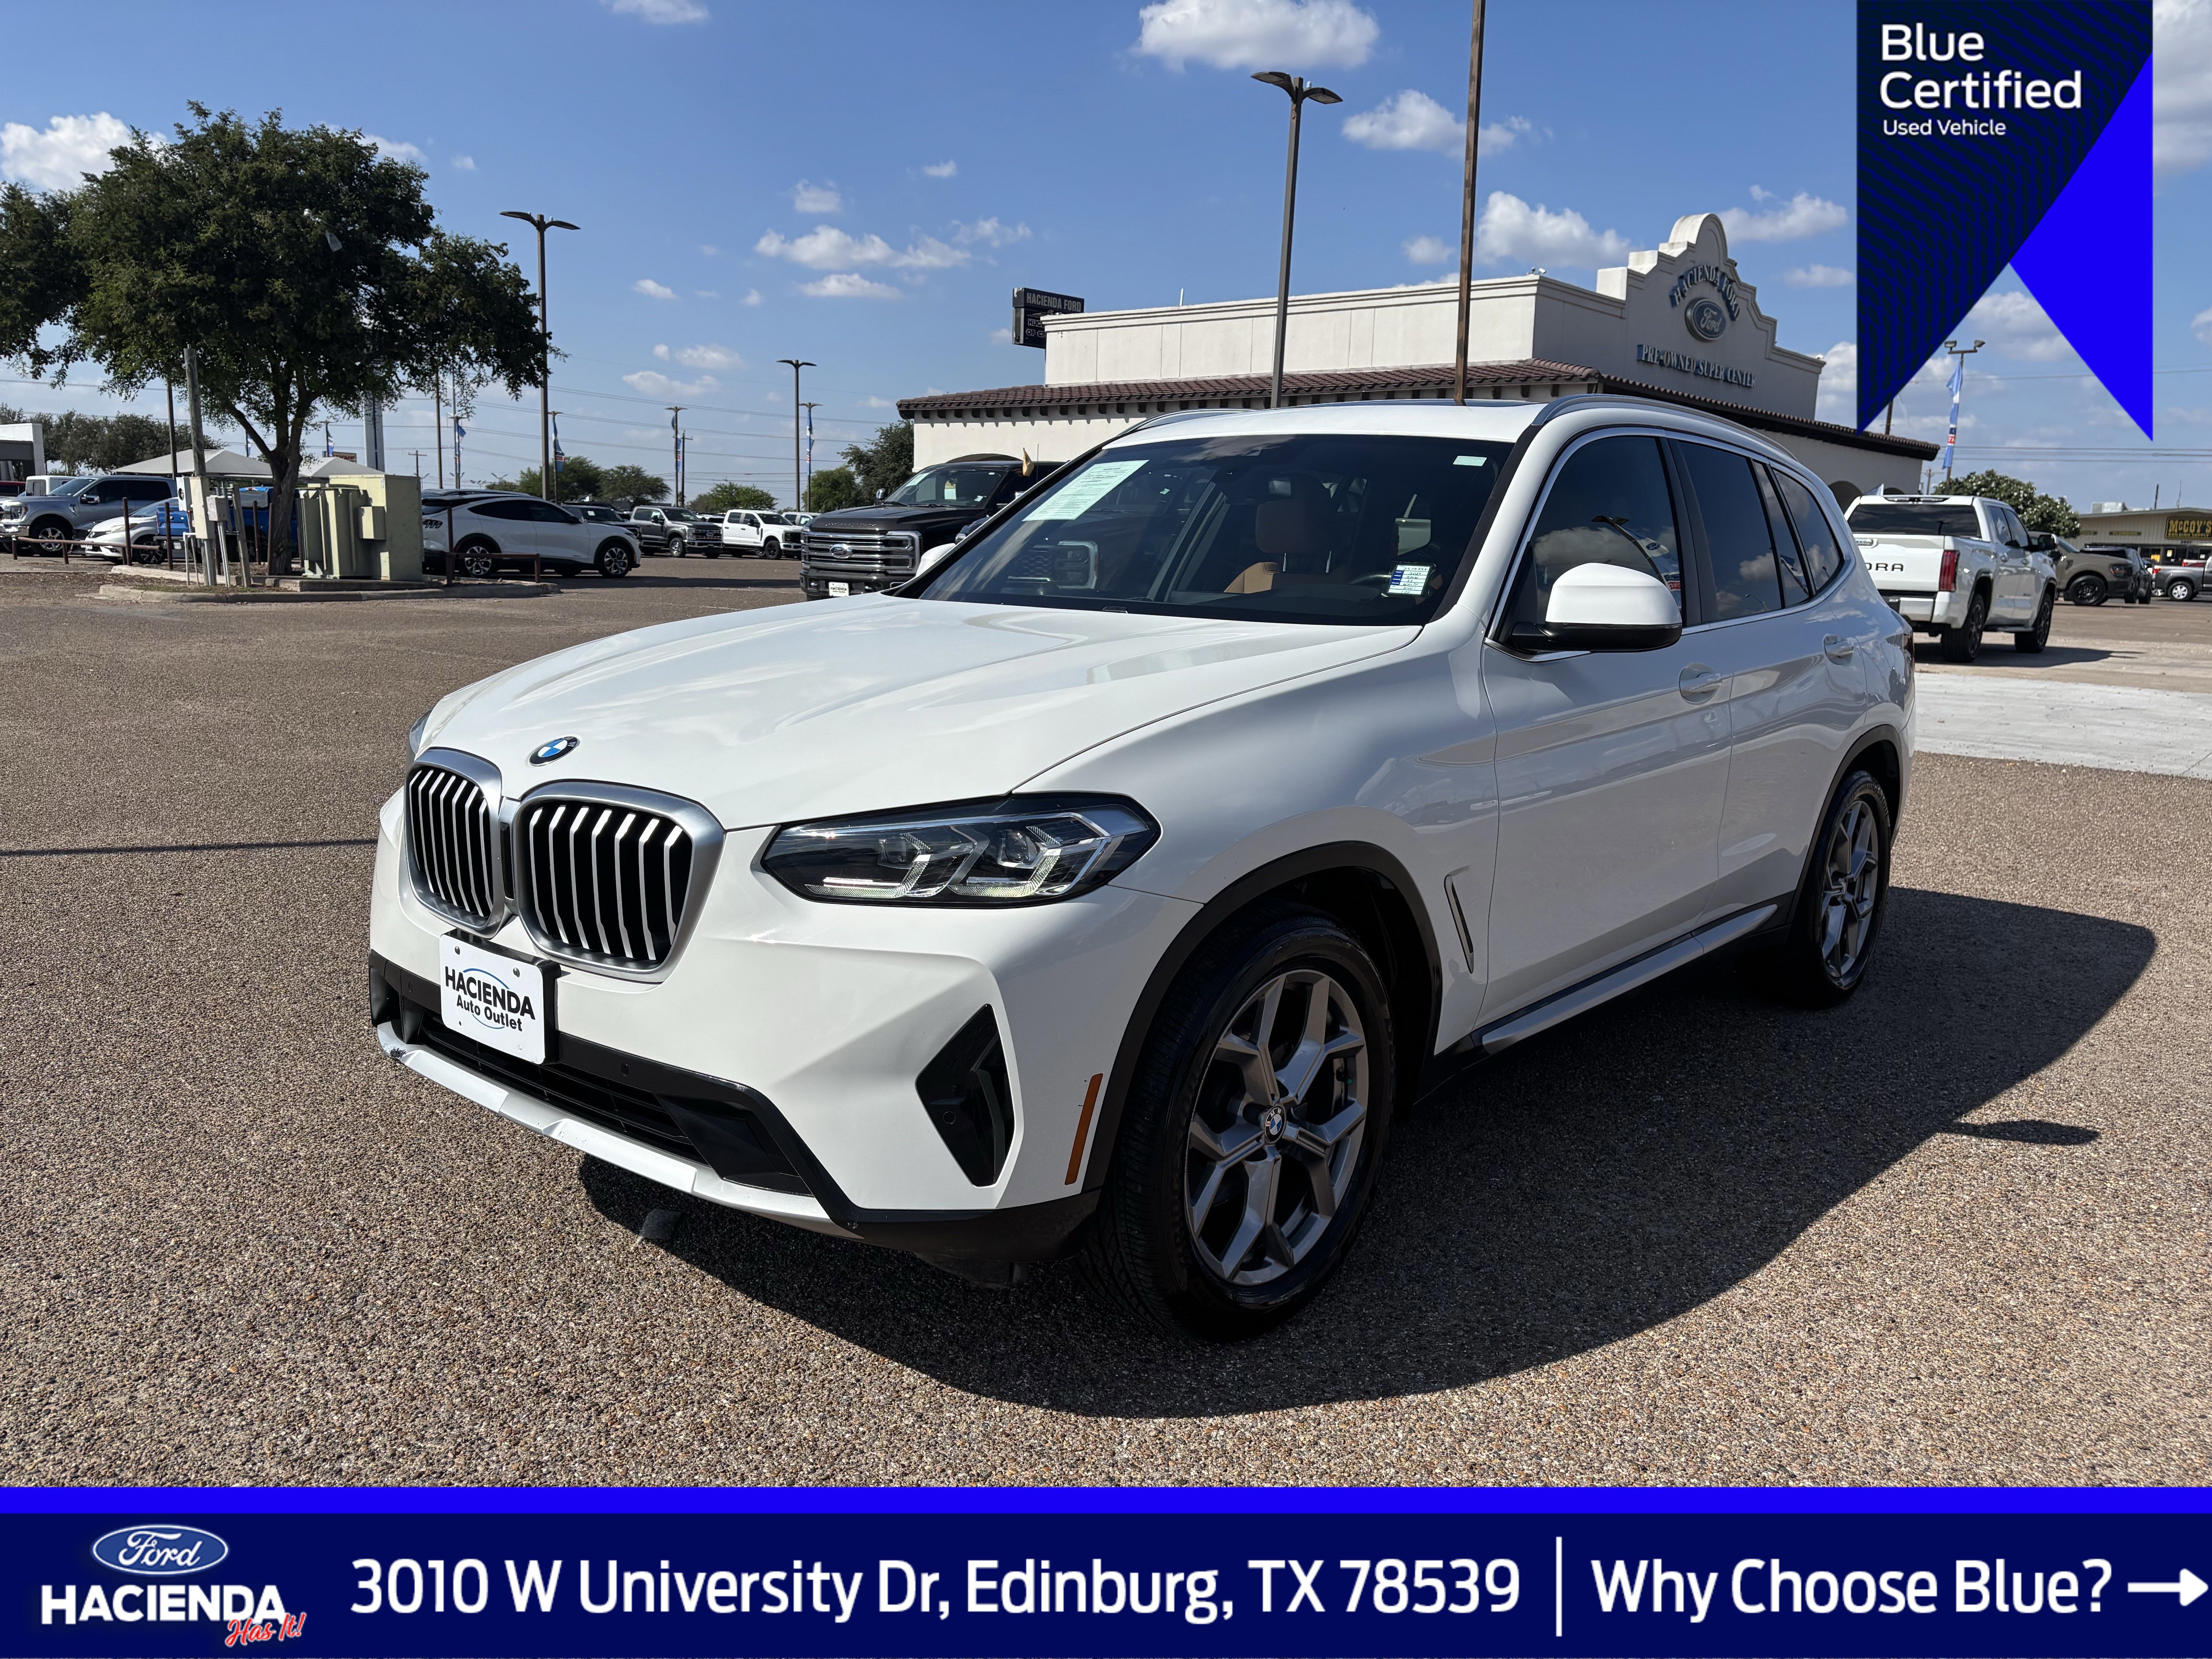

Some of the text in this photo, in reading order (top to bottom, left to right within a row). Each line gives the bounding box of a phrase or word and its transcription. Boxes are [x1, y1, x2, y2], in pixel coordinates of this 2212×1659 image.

[1027, 292, 1082, 312] HACIENDA FORD
[1672, 264, 1740, 318] HACIENDA FORD
[1027, 318, 1045, 328] HUG
[1700, 307, 1723, 333] Ford
[1642, 344, 1757, 387] PRE-OWNED SUPER CENTER
[445, 965, 536, 1020] HACIENDA
[456, 994, 523, 1032] Auto Outlet
[1266, 1108, 1282, 1127] BMW
